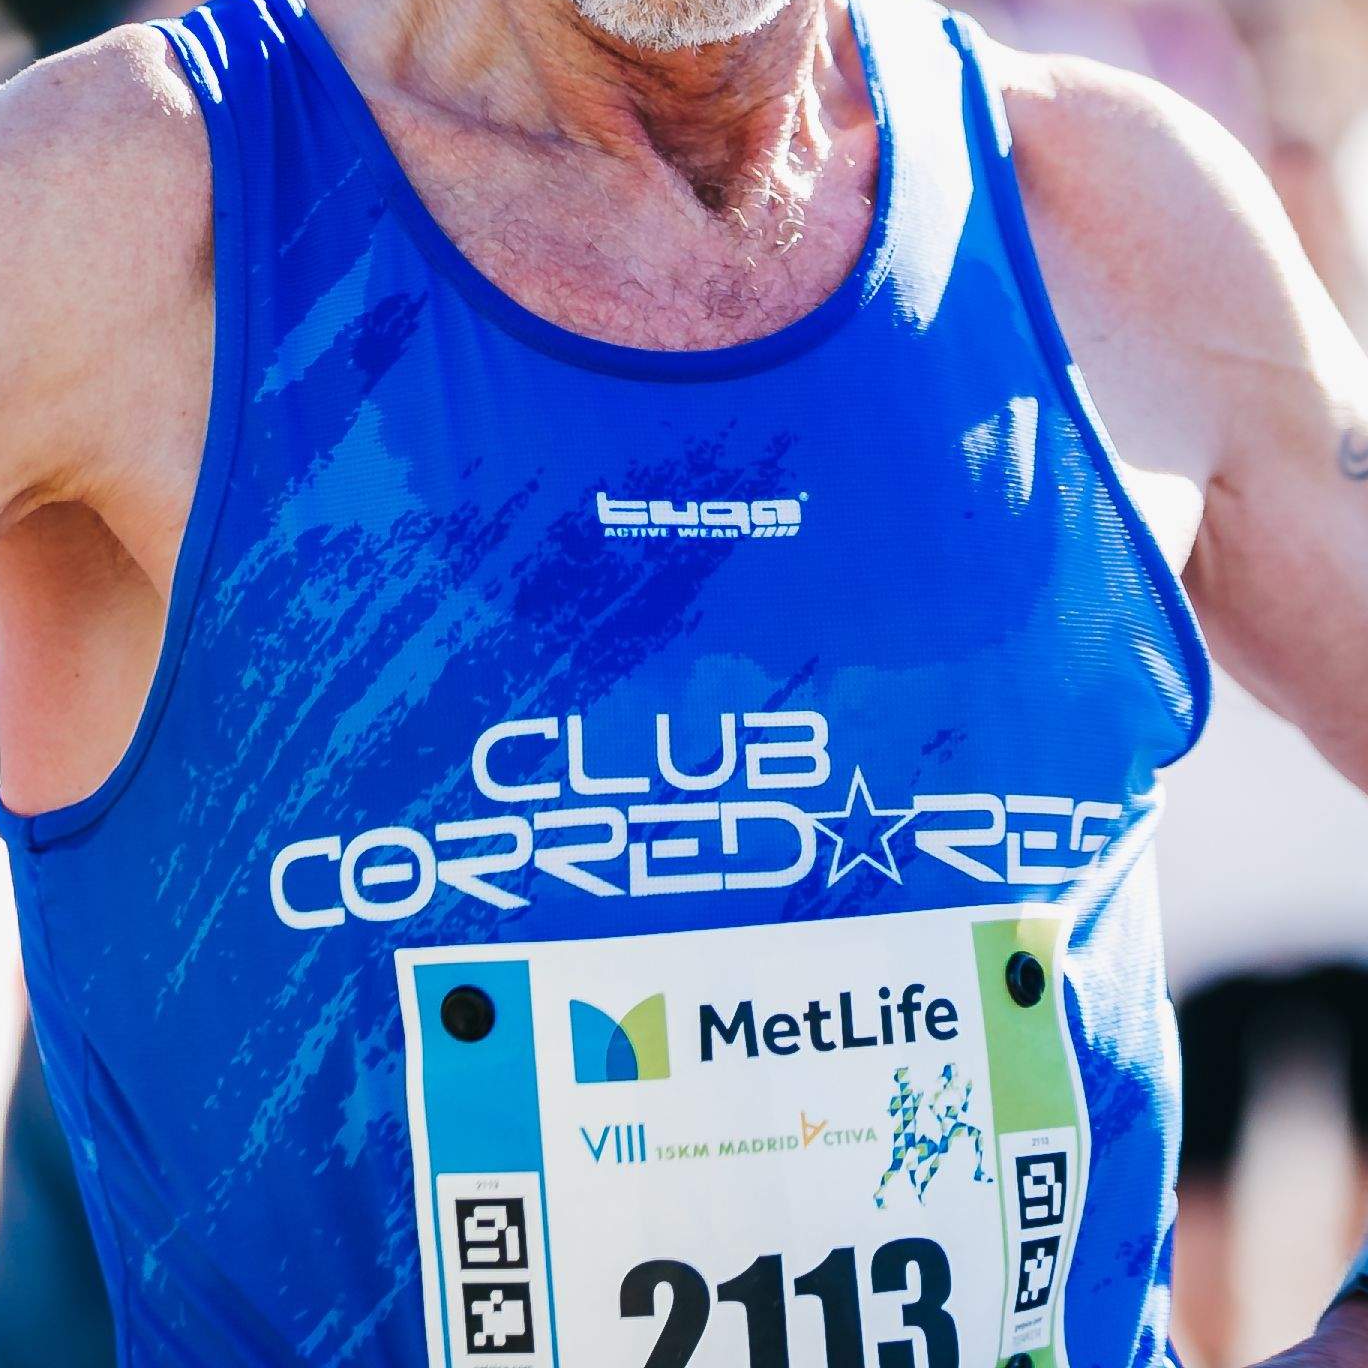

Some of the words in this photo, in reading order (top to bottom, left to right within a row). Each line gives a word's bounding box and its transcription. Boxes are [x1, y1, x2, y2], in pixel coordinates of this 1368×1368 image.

[603, 527, 669, 539] ACTIVE
[677, 527, 739, 539] WEAR
[472, 711, 831, 801] CLUB
[699, 983, 959, 1062] MetLife
[579, 1122, 646, 1164] VIII
[654, 1142, 710, 1161] 15KM
[718, 1134, 799, 1159] MADRID
[619, 1237, 959, 1368] 2113
